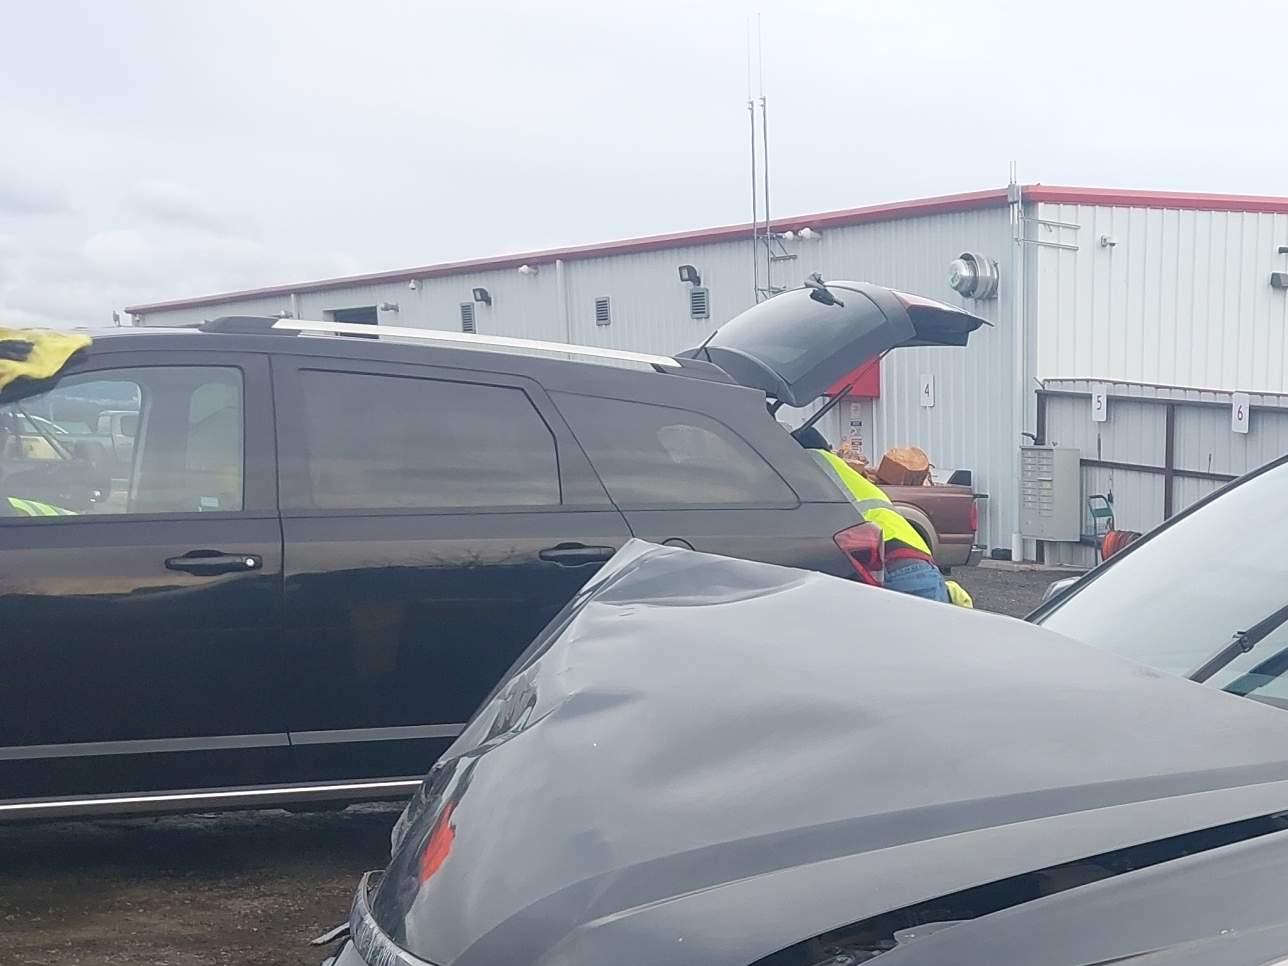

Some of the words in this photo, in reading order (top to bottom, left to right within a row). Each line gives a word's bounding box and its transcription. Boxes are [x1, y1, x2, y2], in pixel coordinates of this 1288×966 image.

[924, 383, 930, 397] 4
[1097, 395, 1103, 411] 5
[1237, 405, 1244, 421] 6
